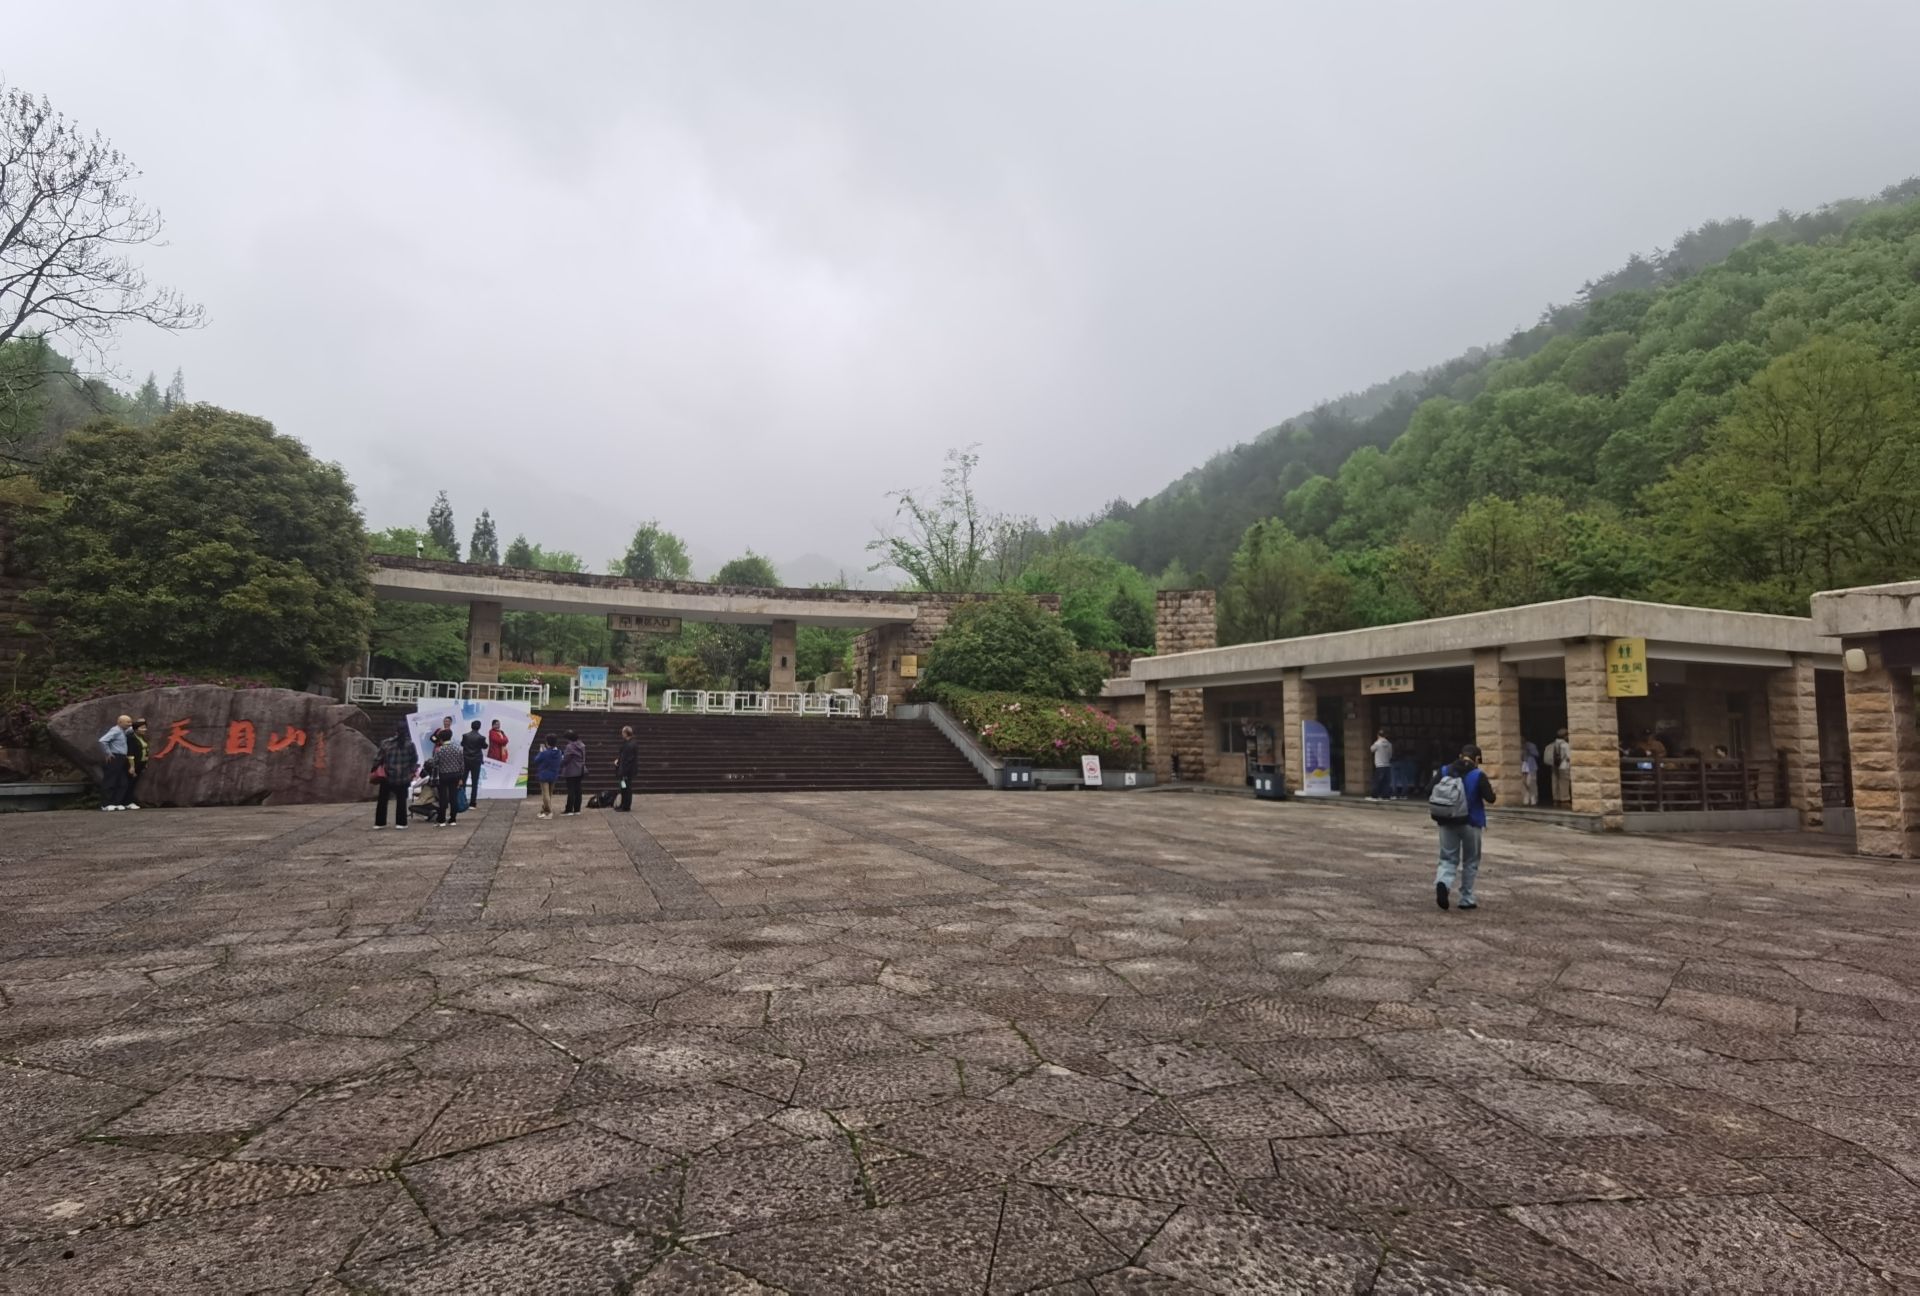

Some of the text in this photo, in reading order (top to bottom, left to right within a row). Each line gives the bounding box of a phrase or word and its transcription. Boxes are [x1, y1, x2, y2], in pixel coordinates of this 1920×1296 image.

[1610, 662, 1643, 673] 卫生间
[154, 718, 307, 759] 天目山
